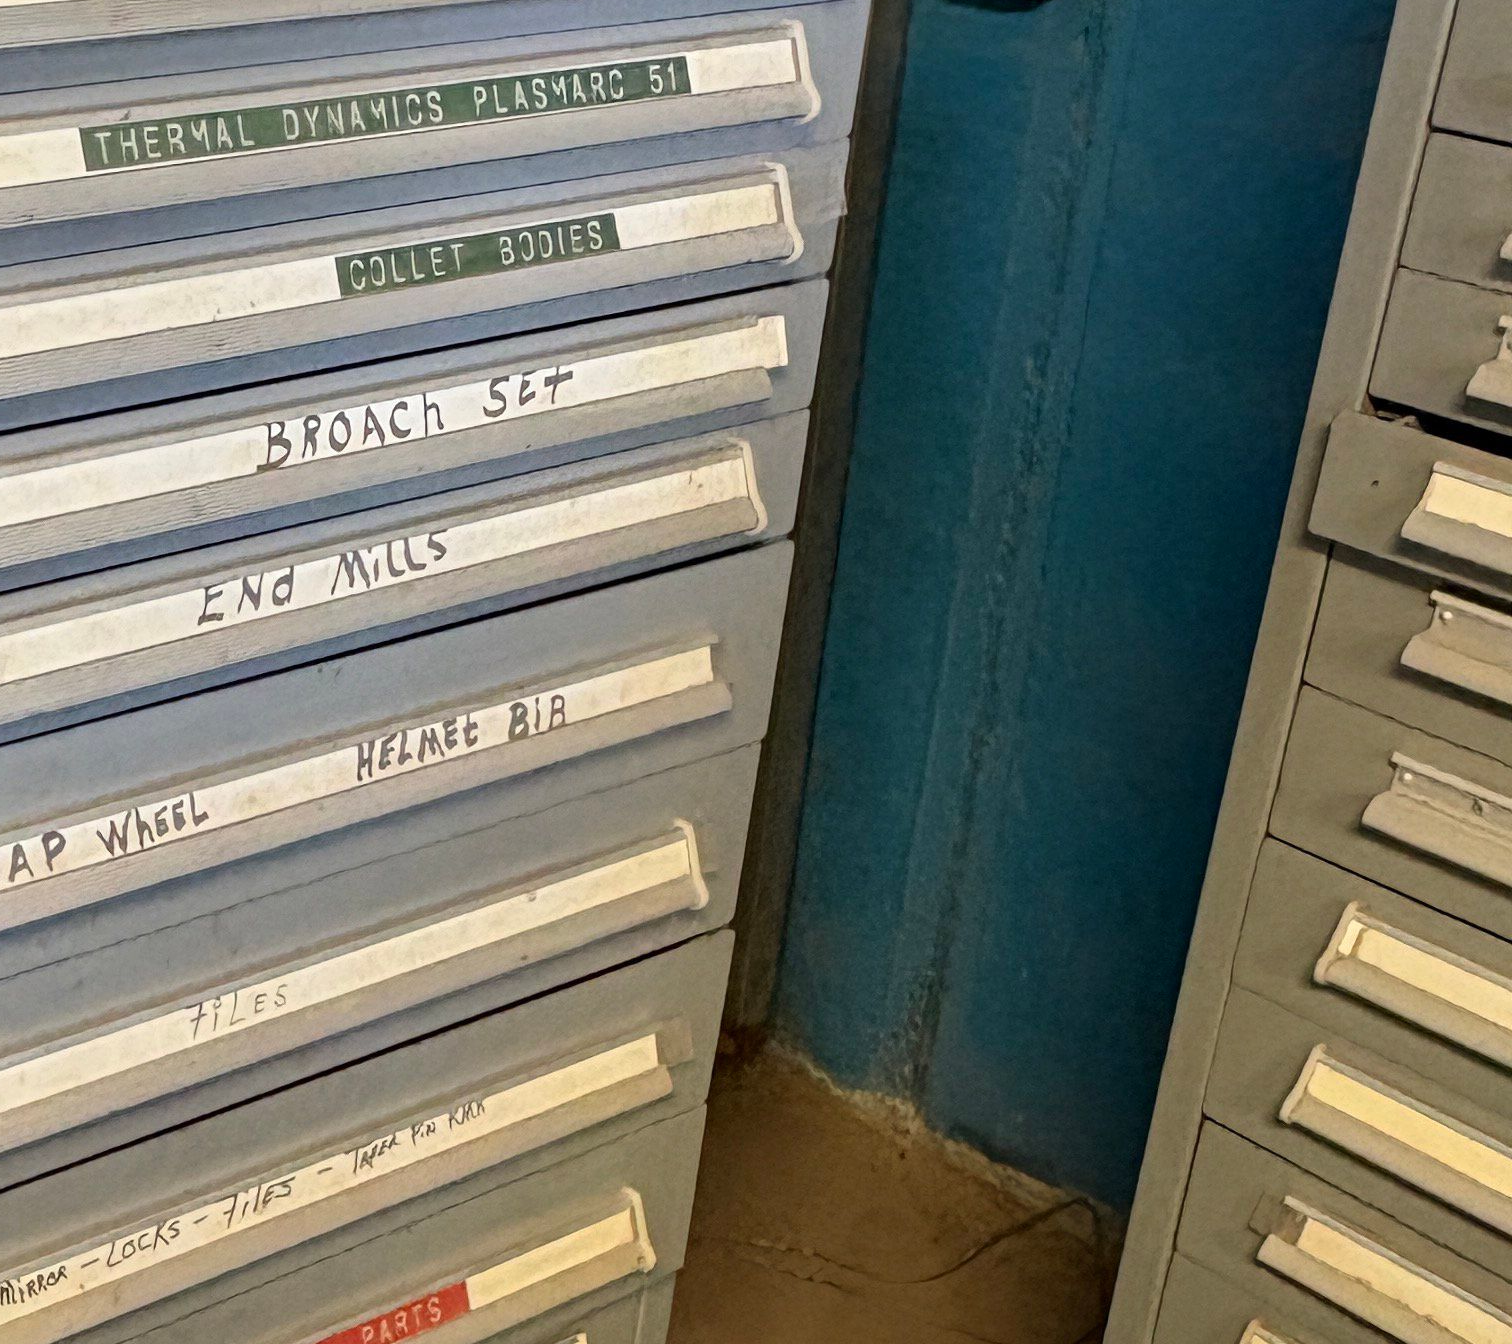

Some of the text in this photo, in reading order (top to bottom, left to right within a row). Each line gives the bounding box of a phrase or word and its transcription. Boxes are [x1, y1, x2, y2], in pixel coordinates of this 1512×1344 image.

[93, 61, 677, 165] THERMAL DYNAMICS PLASMARC 51
[349, 220, 603, 291] COLLET BODIES
[106, 1219, 181, 1267] LOCKS
